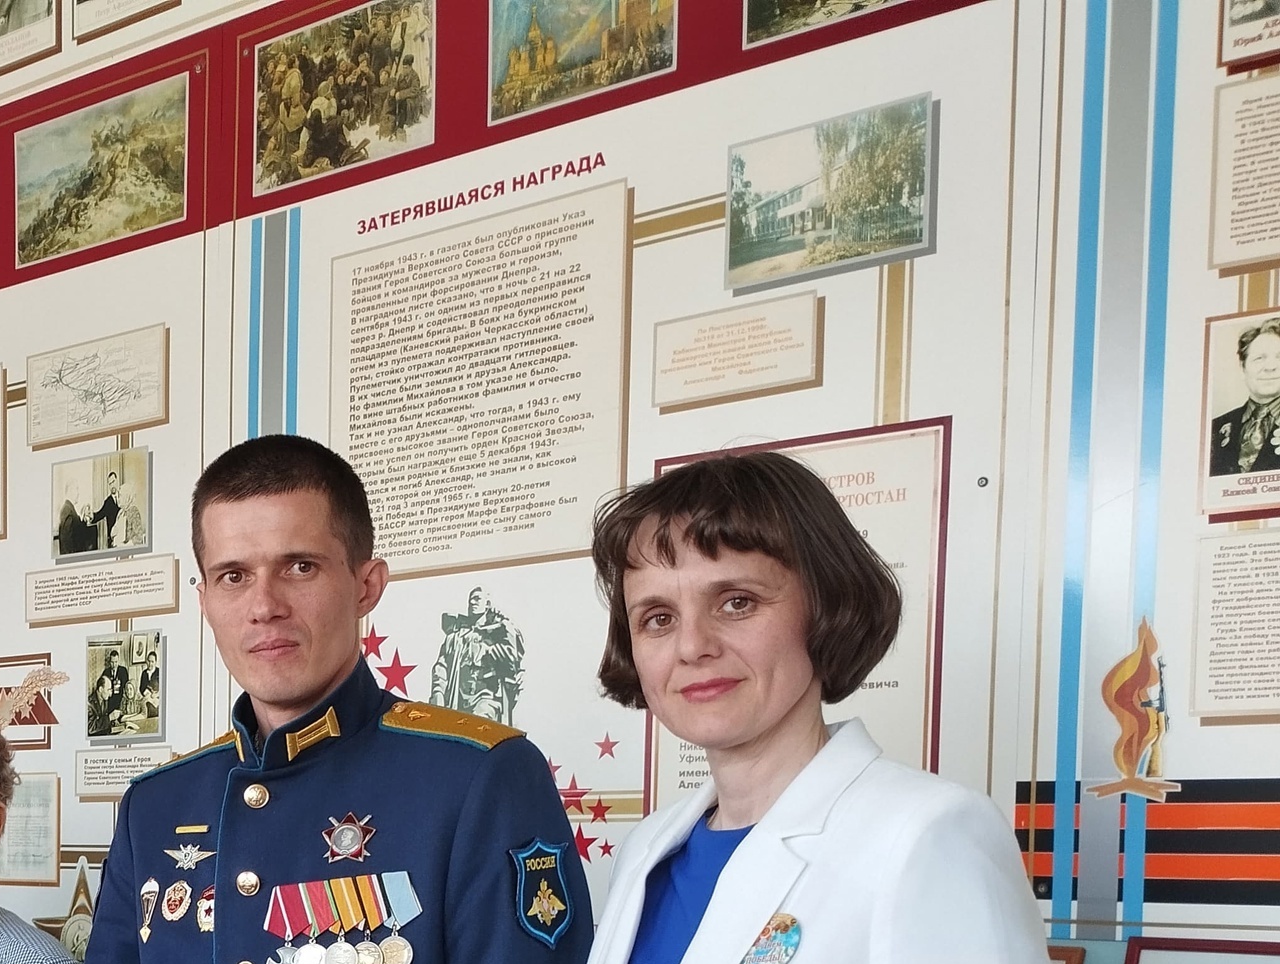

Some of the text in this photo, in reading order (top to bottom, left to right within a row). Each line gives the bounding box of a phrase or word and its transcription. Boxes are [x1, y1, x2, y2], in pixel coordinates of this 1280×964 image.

[357, 152, 606, 235] ЗАТЕРЯВШАЯСЯ НАГРАДА
[351, 267, 406, 287] Президиума
[407, 253, 461, 273] Верховного
[462, 244, 495, 259] Совета
[497, 234, 524, 250] СССР
[534, 218, 595, 241] присвоении
[351, 233, 578, 297] звания Героя Советского Союза большой группе
[363, 260, 395, 274] ноября
[397, 252, 418, 265] 1943
[436, 239, 472, 255] газетах
[474, 234, 494, 245] был
[496, 216, 560, 240] опубликован
[562, 209, 586, 222] Указ
[350, 293, 382, 307] бойцов
[391, 277, 446, 297] командиров
[461, 262, 508, 280] мужество
[518, 246, 563, 265] героизм,
[350, 265, 540, 317] проявленные при форсировании Днепра.
[526, 856, 555, 871] РОССИЯ
